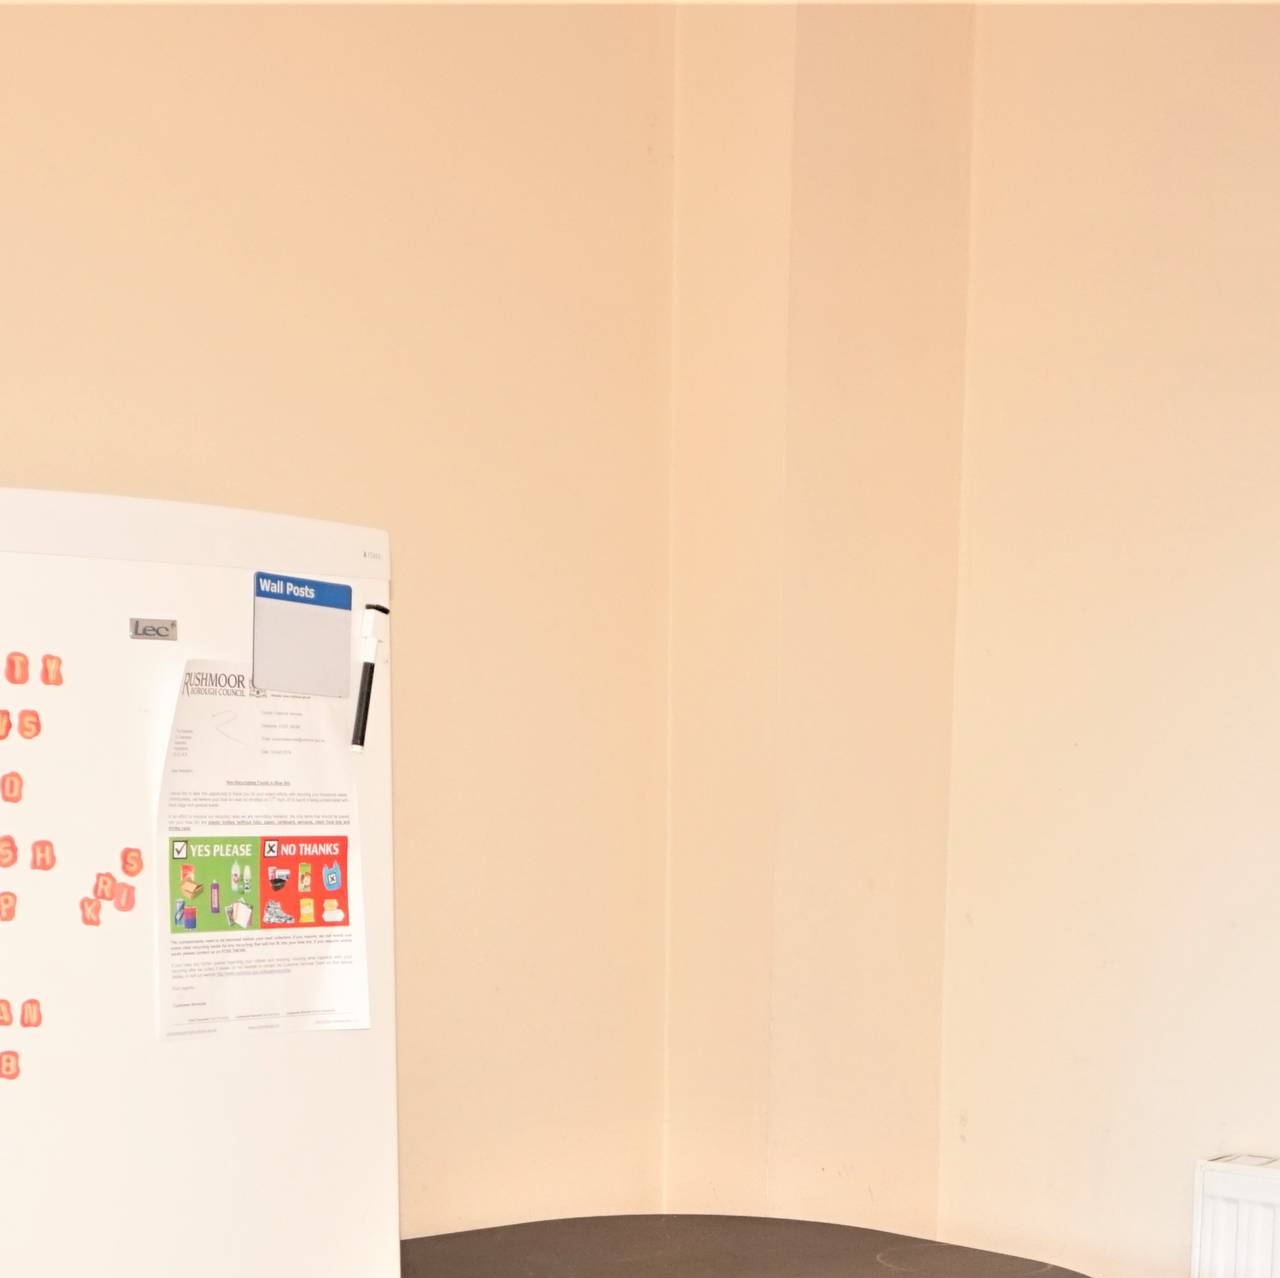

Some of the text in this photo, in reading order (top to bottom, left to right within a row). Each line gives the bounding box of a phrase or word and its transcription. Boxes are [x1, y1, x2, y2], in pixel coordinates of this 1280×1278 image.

[259, 577, 315, 599] Wall Posts
[134, 620, 169, 638] Lec
[182, 672, 246, 698] RUSHMOOR
[190, 843, 340, 857] YES PLEASE NO THANKS
